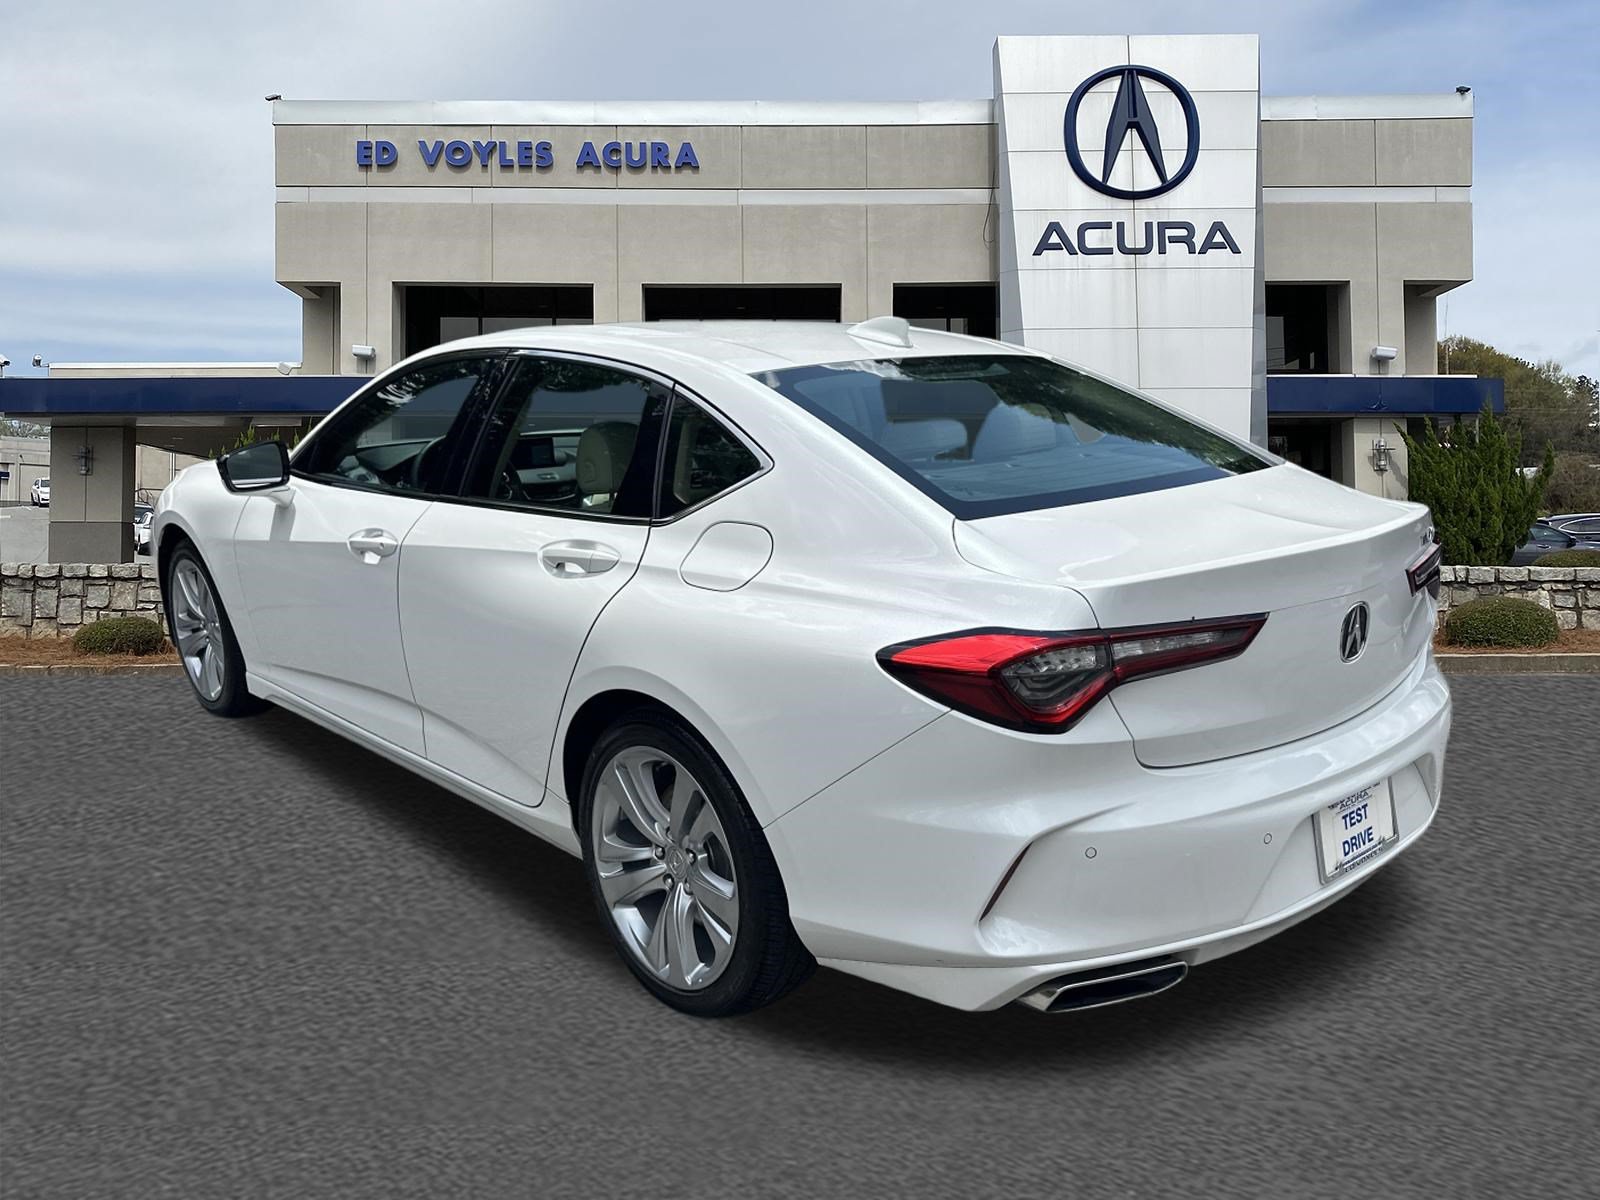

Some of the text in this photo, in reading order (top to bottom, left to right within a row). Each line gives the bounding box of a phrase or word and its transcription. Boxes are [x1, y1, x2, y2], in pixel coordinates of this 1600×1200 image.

[356, 140, 700, 168] ED VOYLES ACURA
[1032, 221, 1241, 256] ACURA
[1342, 803, 1369, 830] TEST
[1342, 826, 1374, 858] DRIVE
